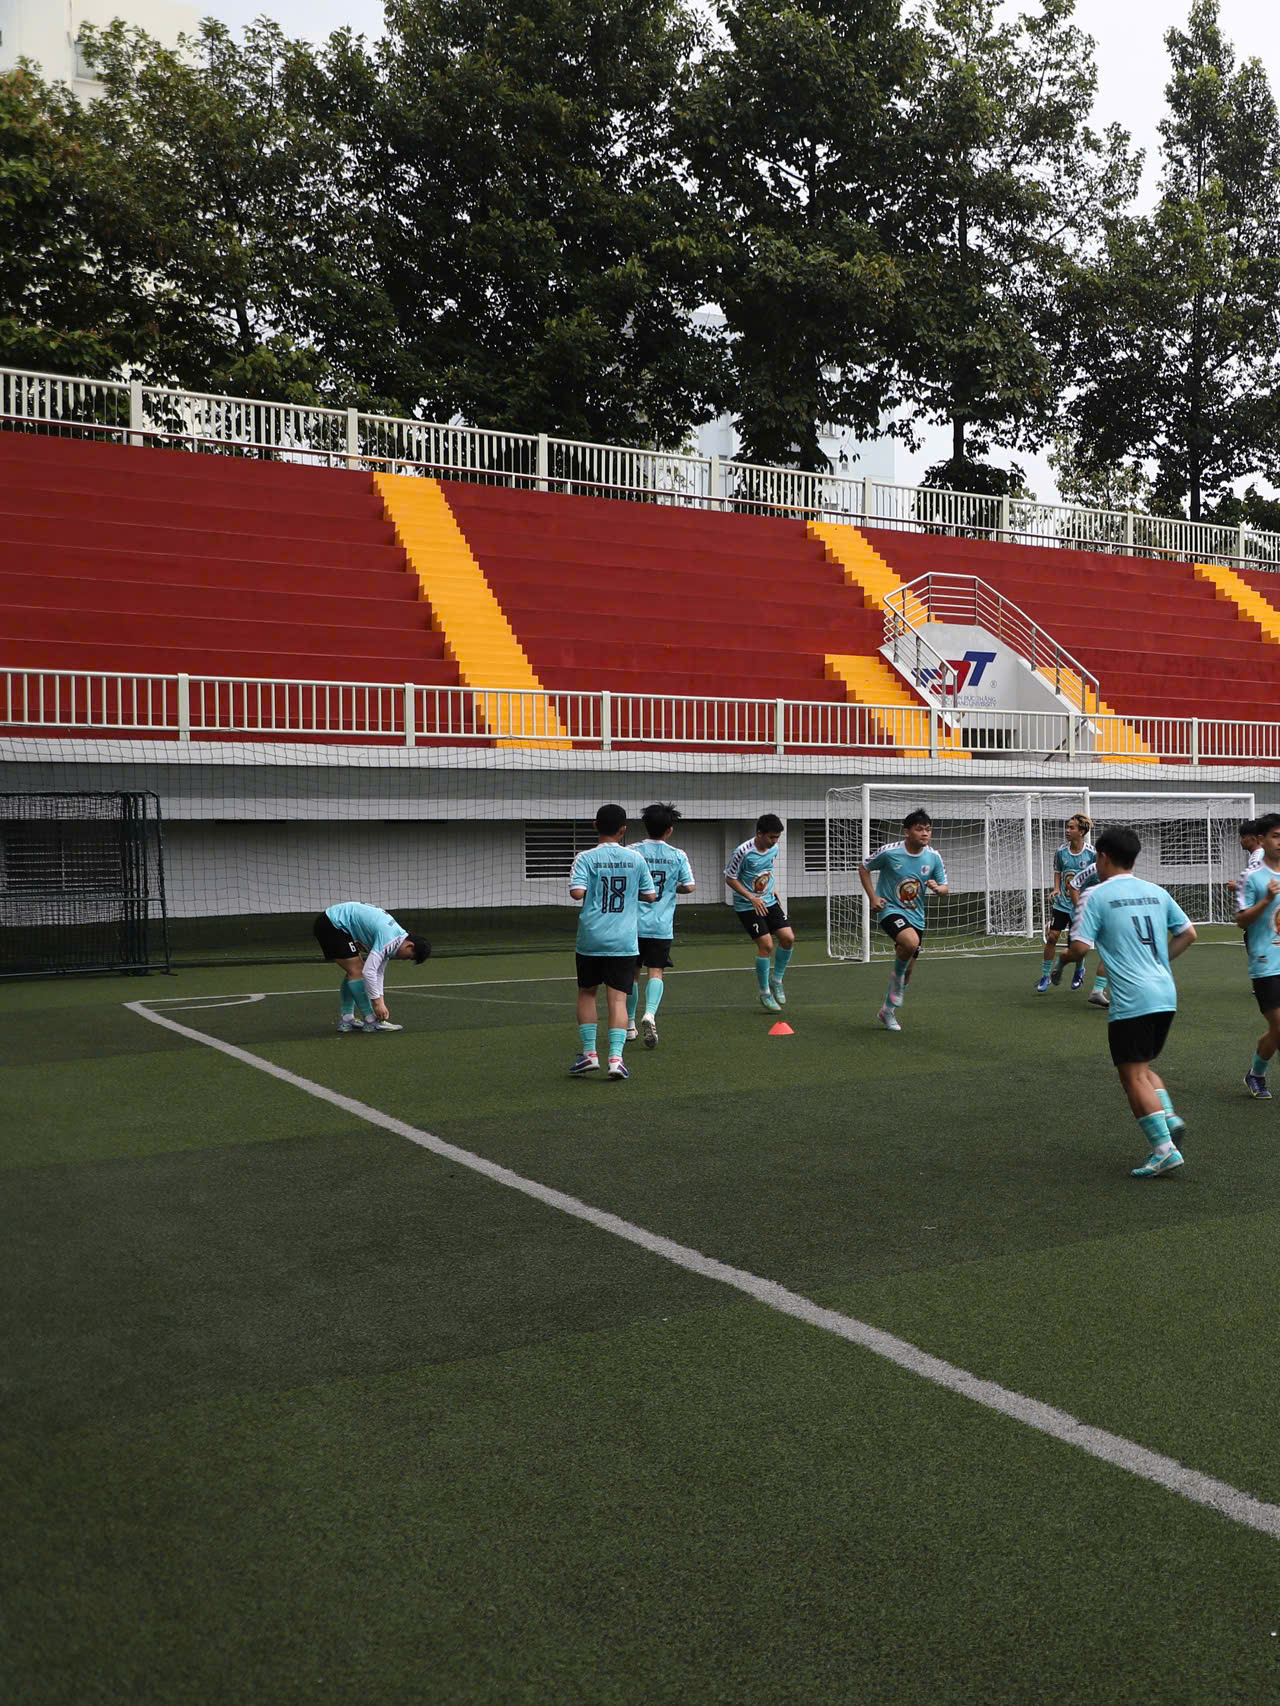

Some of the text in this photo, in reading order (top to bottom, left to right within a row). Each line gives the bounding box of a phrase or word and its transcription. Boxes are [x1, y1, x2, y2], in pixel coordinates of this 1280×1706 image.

[601, 876, 627, 914] 18
[752, 923, 760, 934] 7
[1131, 915, 1162, 966] 4
[348, 941, 357, 953] 6
